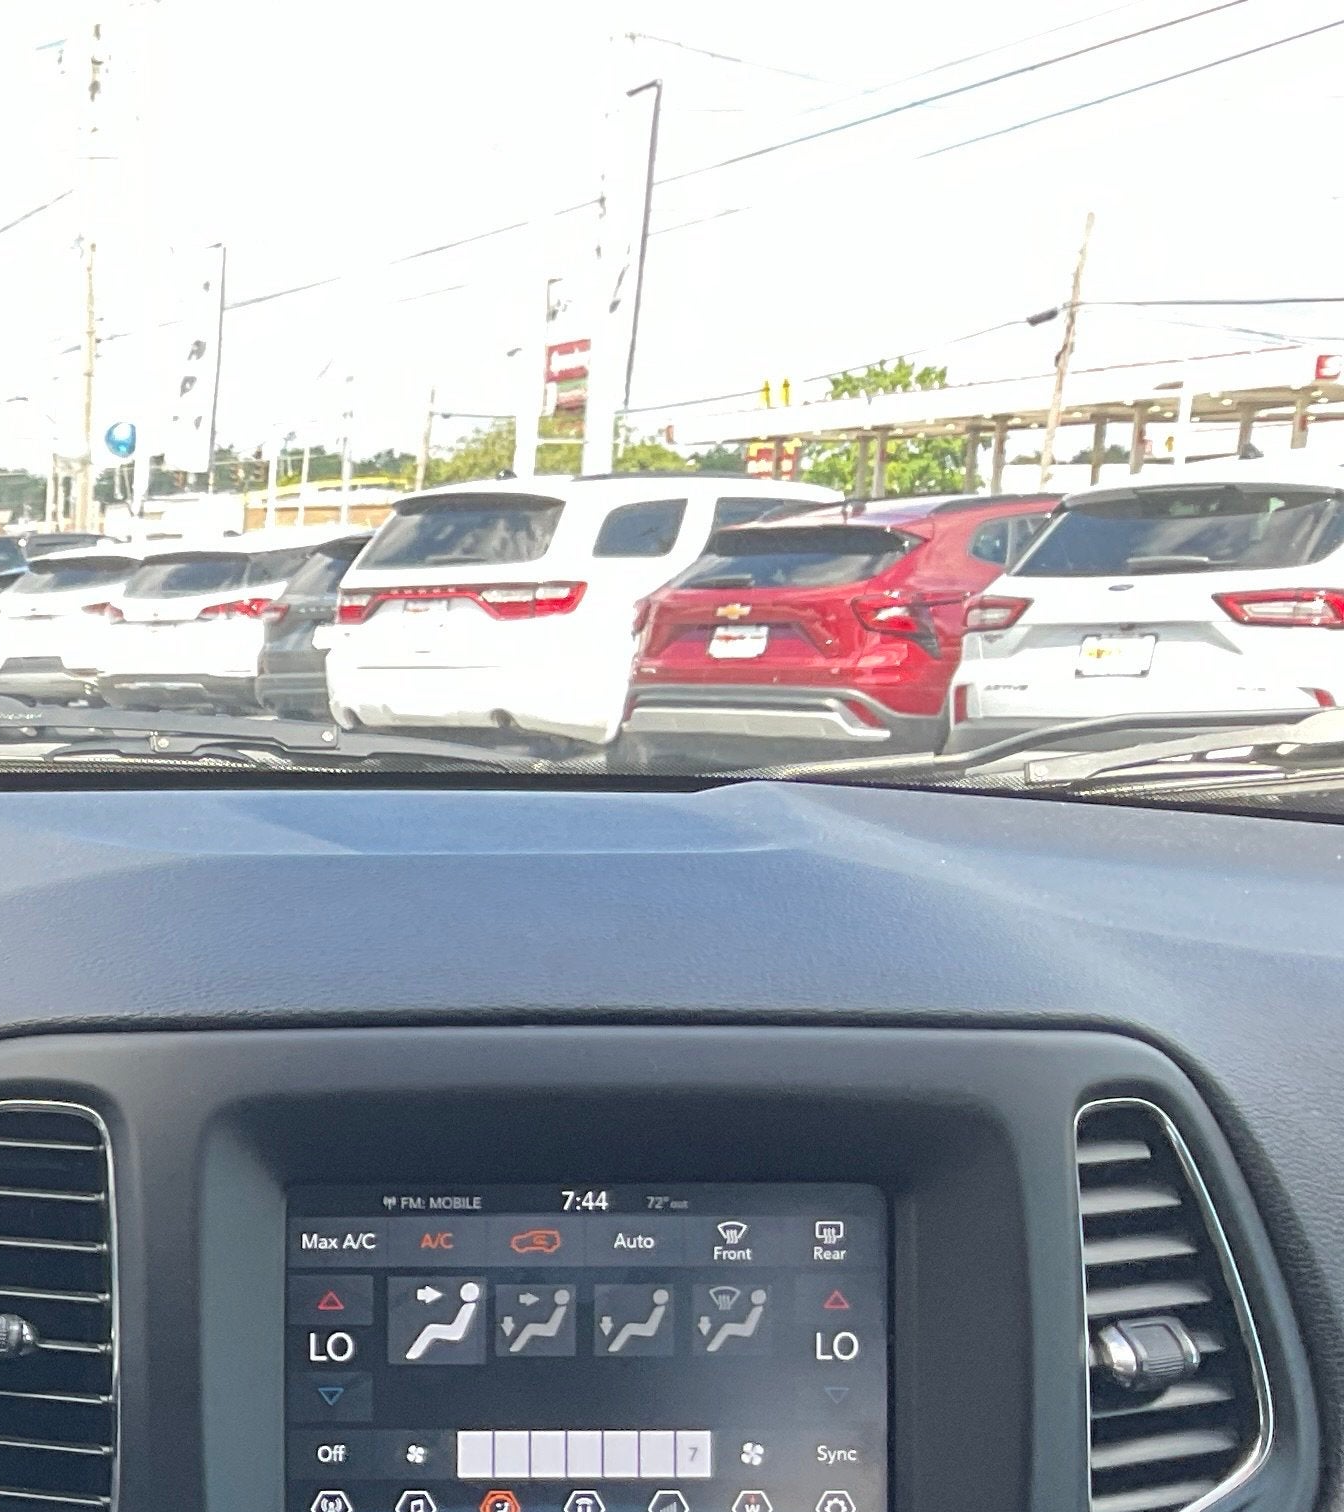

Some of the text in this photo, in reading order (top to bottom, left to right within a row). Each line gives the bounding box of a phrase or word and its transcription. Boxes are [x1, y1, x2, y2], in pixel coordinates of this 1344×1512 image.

[401, 1196, 481, 1209] FM: MOBILE
[561, 1190, 609, 1211] 7:44
[301, 1232, 376, 1249] Max A/C
[420, 1232, 454, 1249] A/C
[613, 1233, 655, 1249] Auto
[713, 1246, 752, 1261] Front
[813, 1246, 846, 1261] Rear
[309, 1332, 354, 1362] LO
[815, 1332, 859, 1362] LO
[317, 1444, 346, 1462] Off
[687, 1446, 699, 1462] 7
[816, 1445, 857, 1465] Sync
